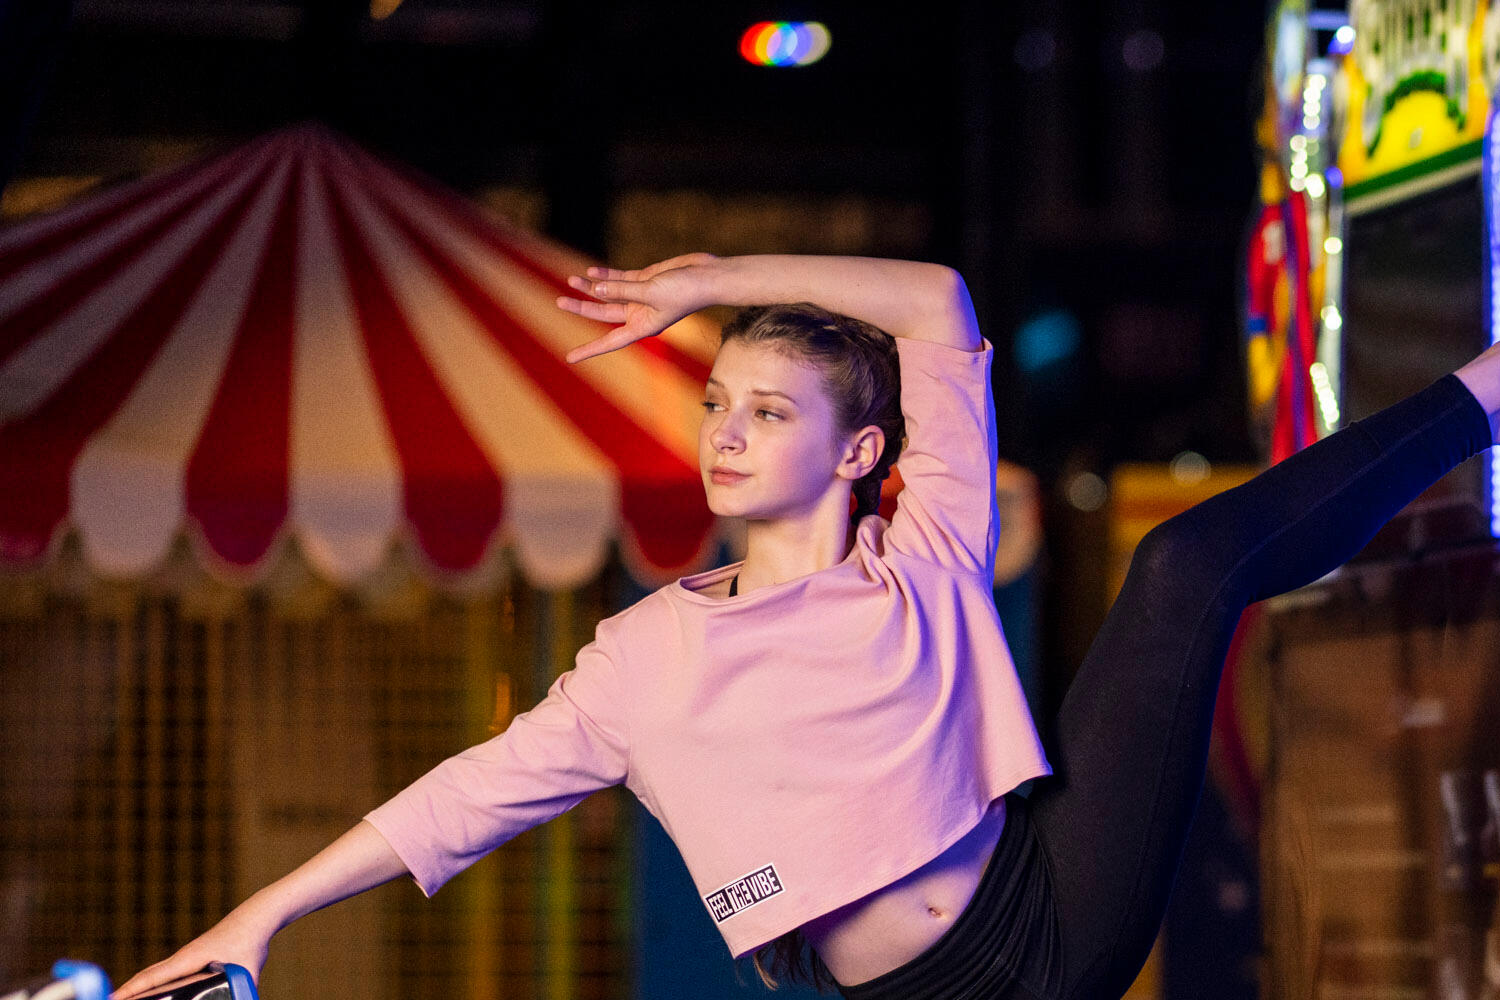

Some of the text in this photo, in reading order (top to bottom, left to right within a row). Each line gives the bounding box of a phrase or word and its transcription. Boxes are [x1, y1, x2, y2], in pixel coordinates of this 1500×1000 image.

[708, 868, 780, 920] FEEL THE VIBE
